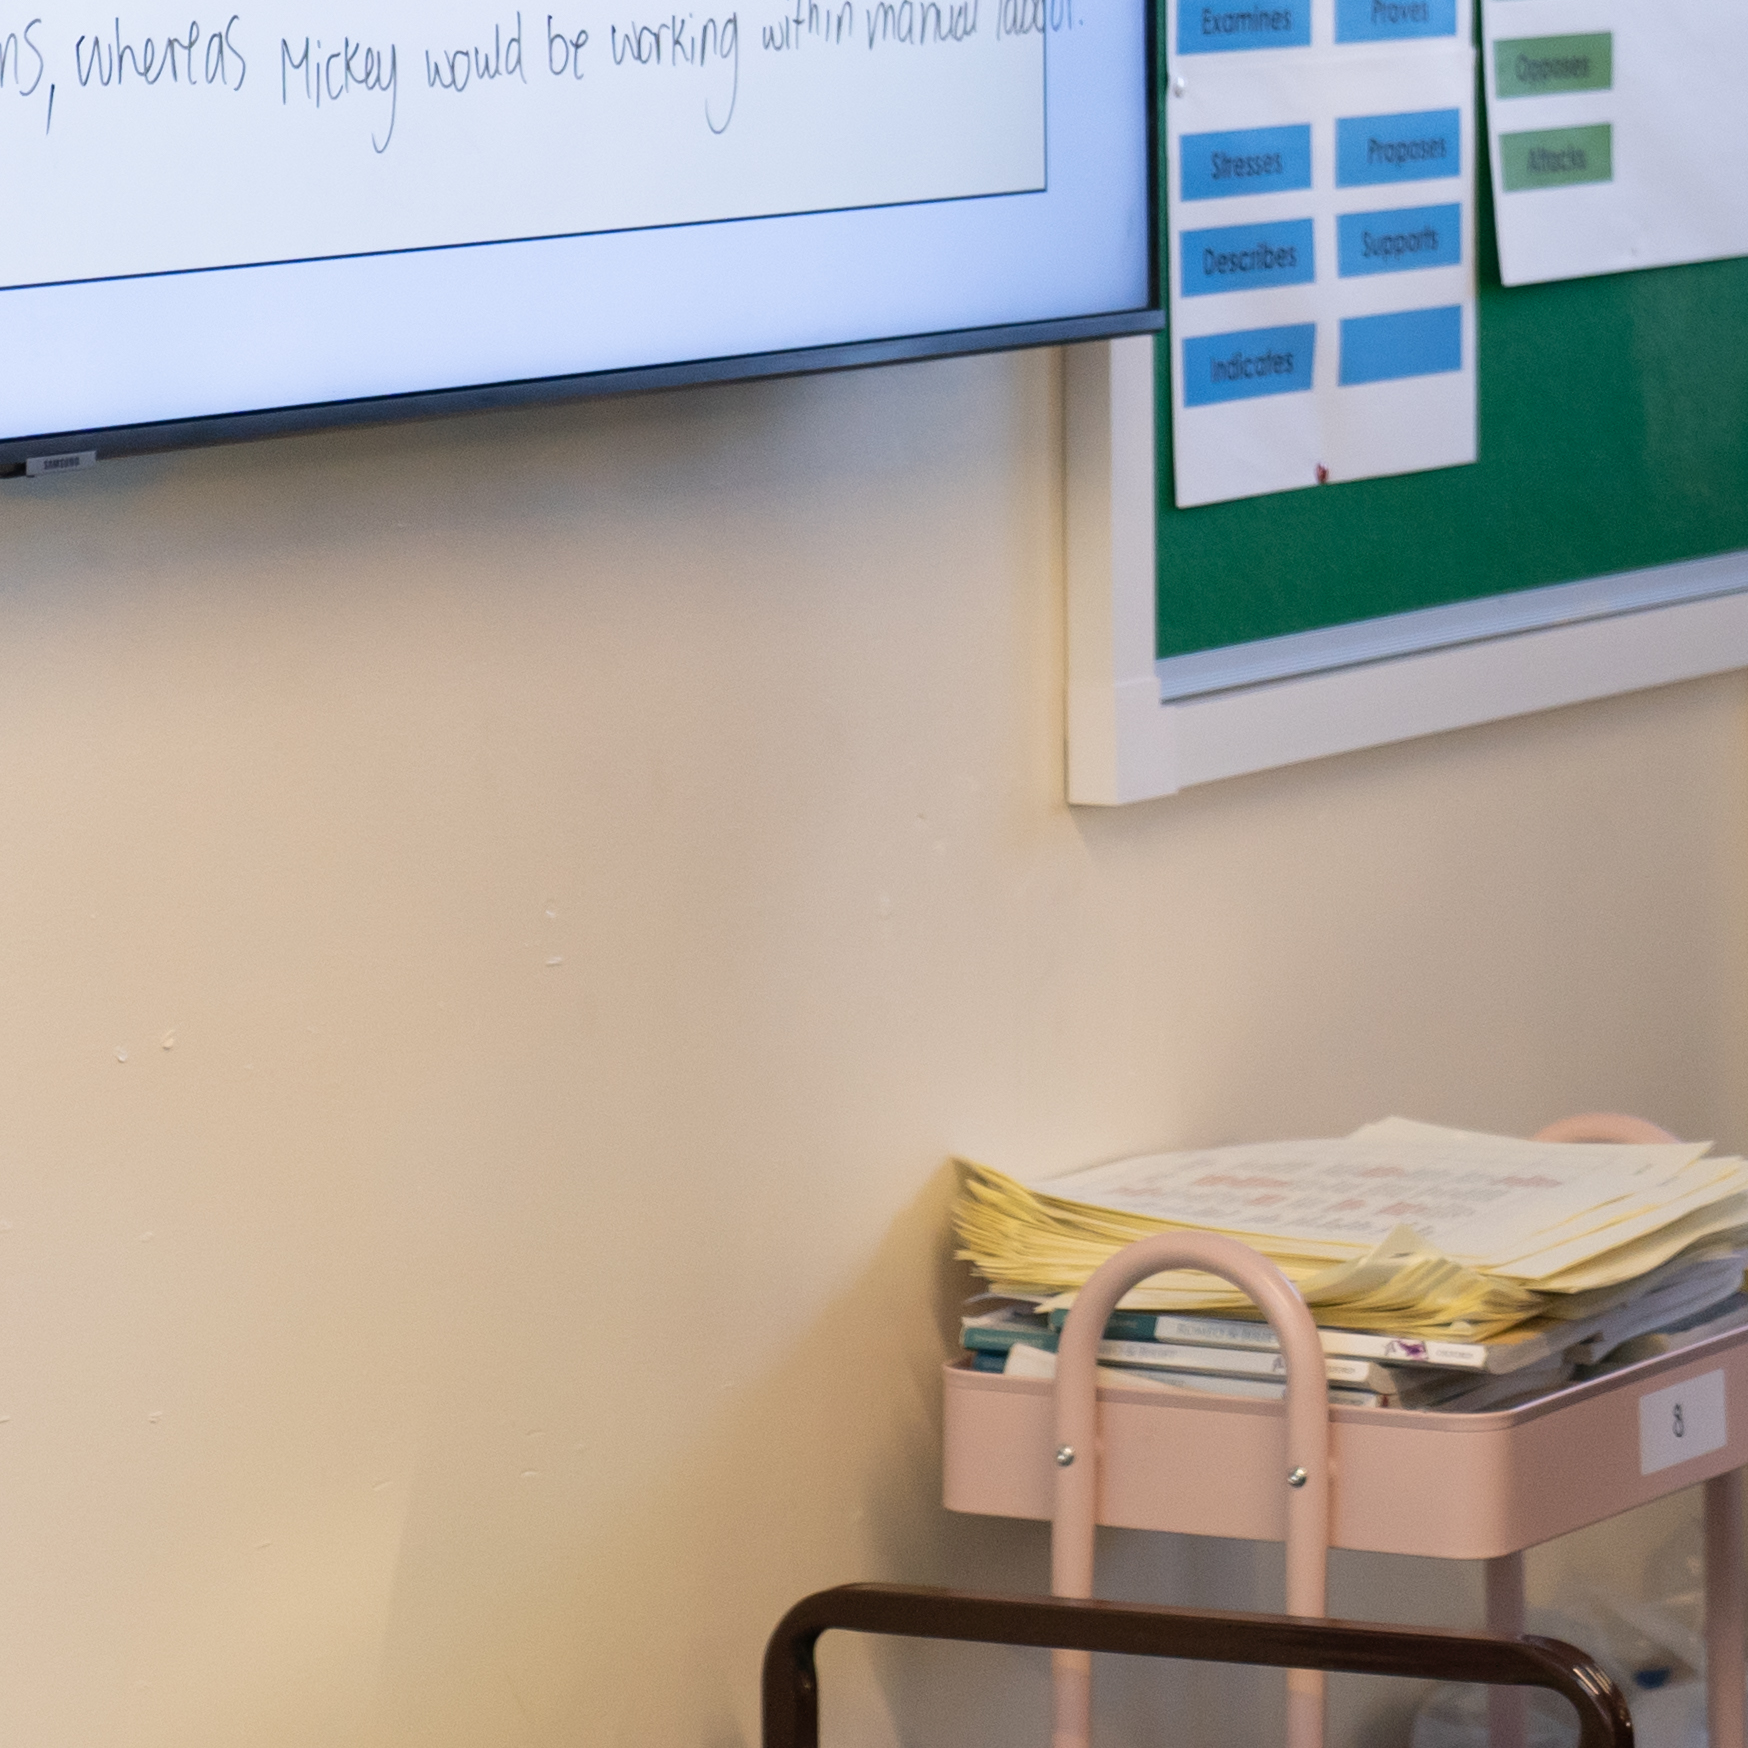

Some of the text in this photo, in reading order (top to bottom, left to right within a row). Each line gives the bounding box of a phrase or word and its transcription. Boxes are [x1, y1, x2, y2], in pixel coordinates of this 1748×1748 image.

[1200, 5, 1293, 36] Examines
[75, 14, 247, 92] whereas
[281, 34, 398, 155] Mickey
[424, 10, 529, 93] would
[546, 14, 590, 81] be
[611, 10, 739, 136] working
[1210, 149, 1283, 182] Stresses
[1202, 243, 1298, 276] Describes
[1209, 350, 1295, 385] Indicates
[1672, 1403, 1686, 1438] 8
